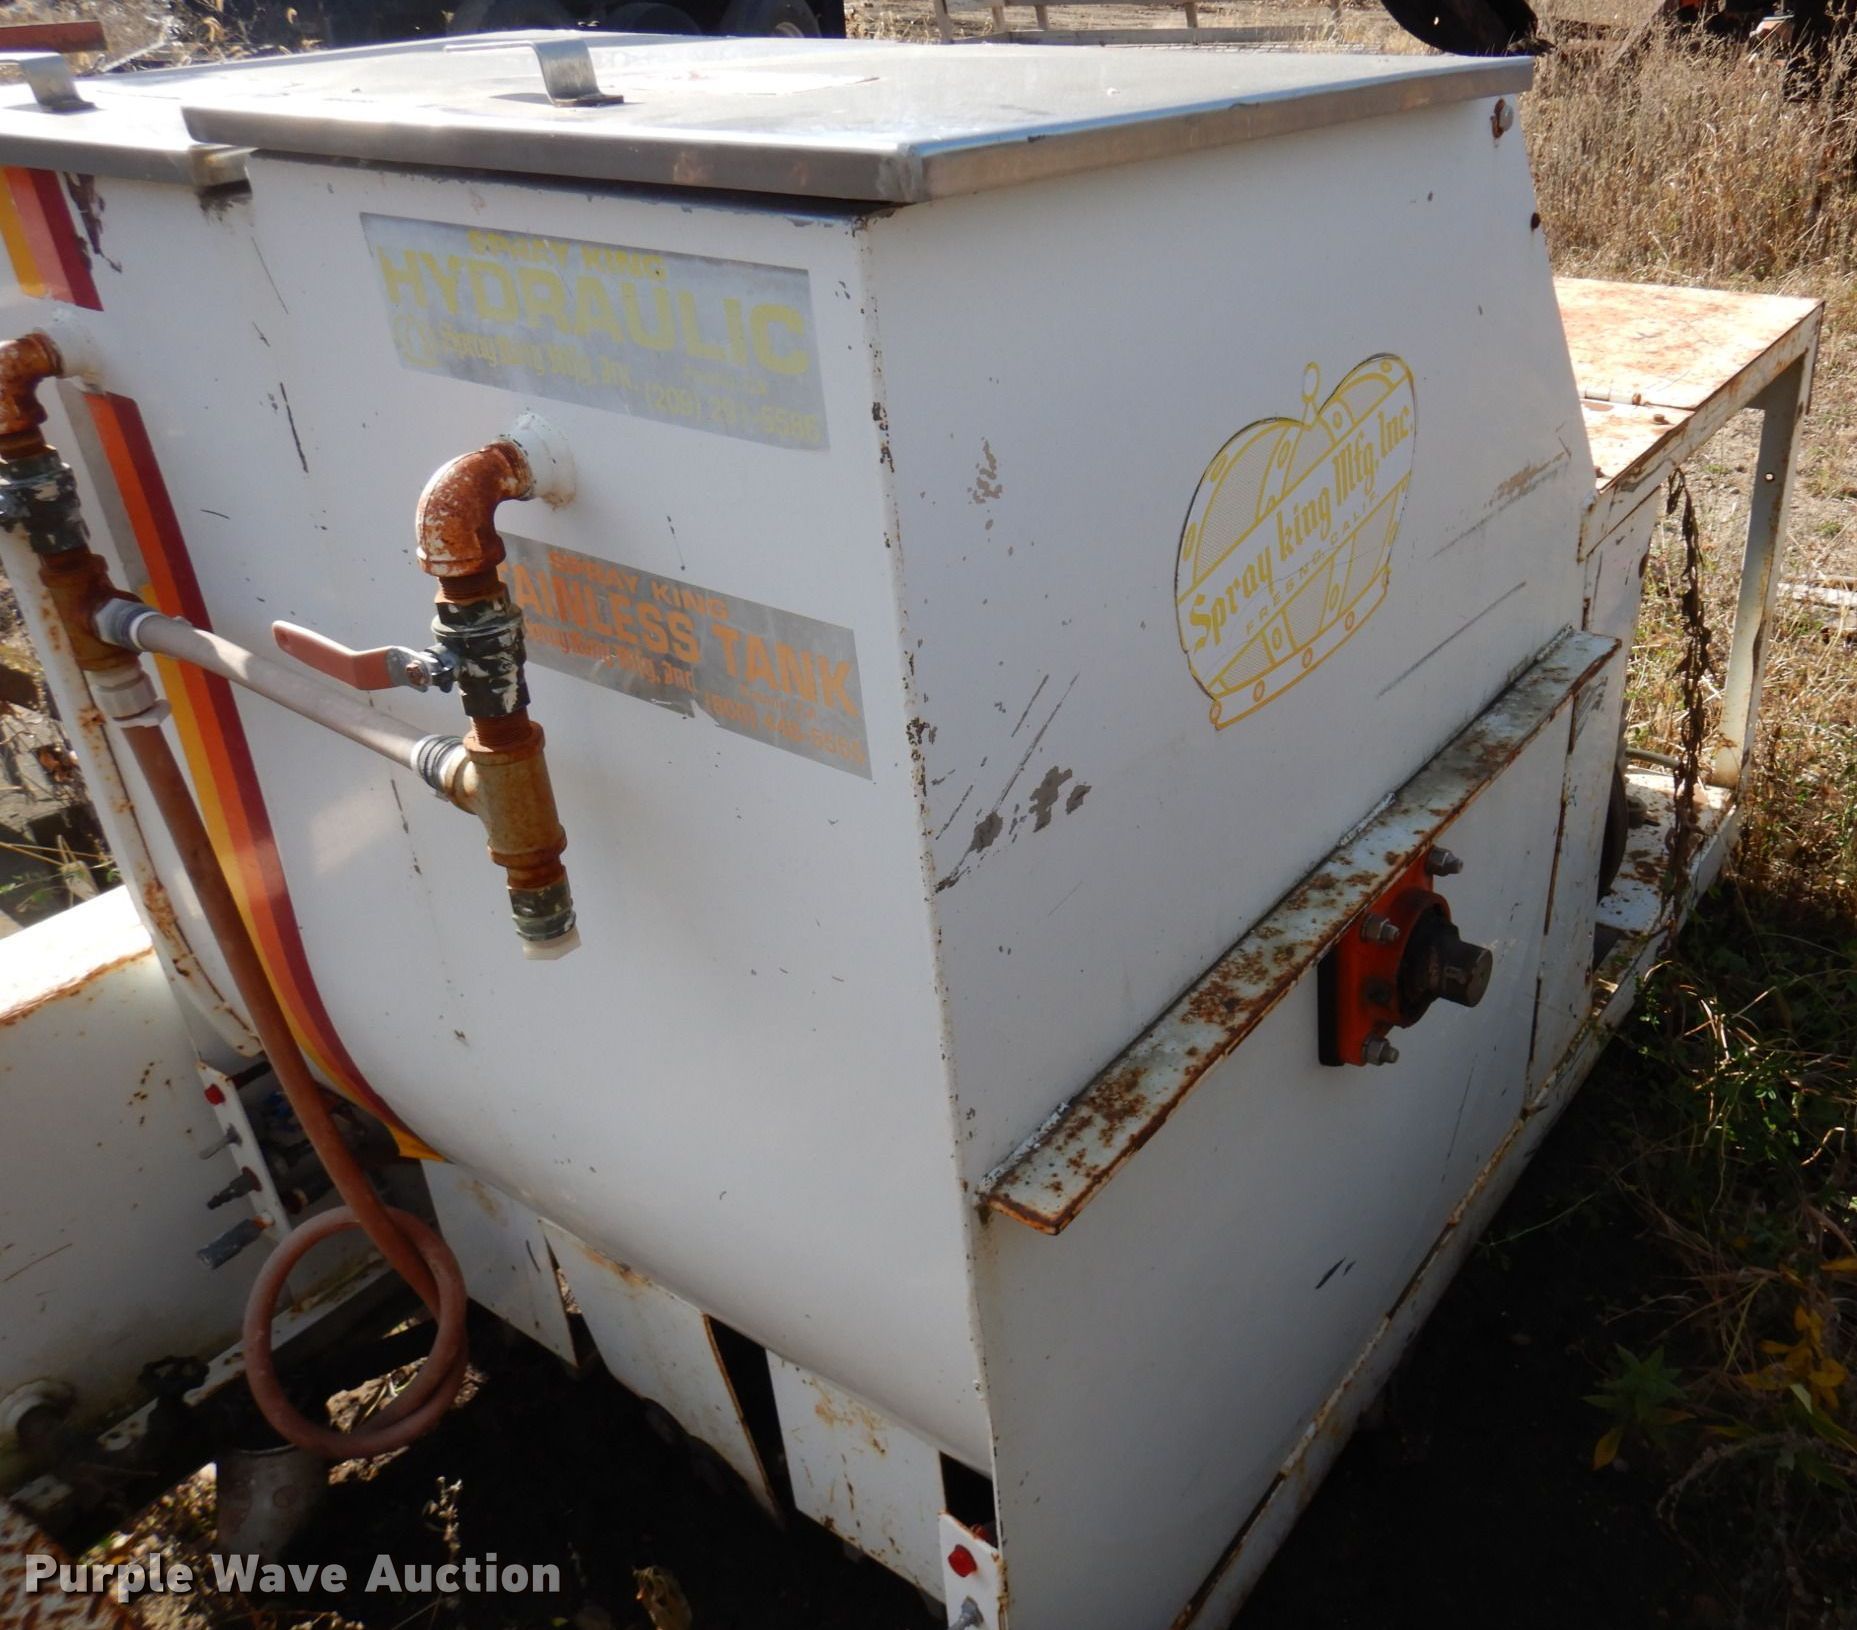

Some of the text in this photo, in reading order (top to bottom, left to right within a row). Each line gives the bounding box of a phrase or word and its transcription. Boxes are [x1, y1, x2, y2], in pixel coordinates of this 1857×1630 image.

[377, 247, 810, 376] HYDRAULIC
[581, 243, 667, 281] KING
[548, 550, 729, 621] SPRAY KING
[1189, 546, 1276, 654] Spray
[497, 564, 860, 718] AINLESS TANK
